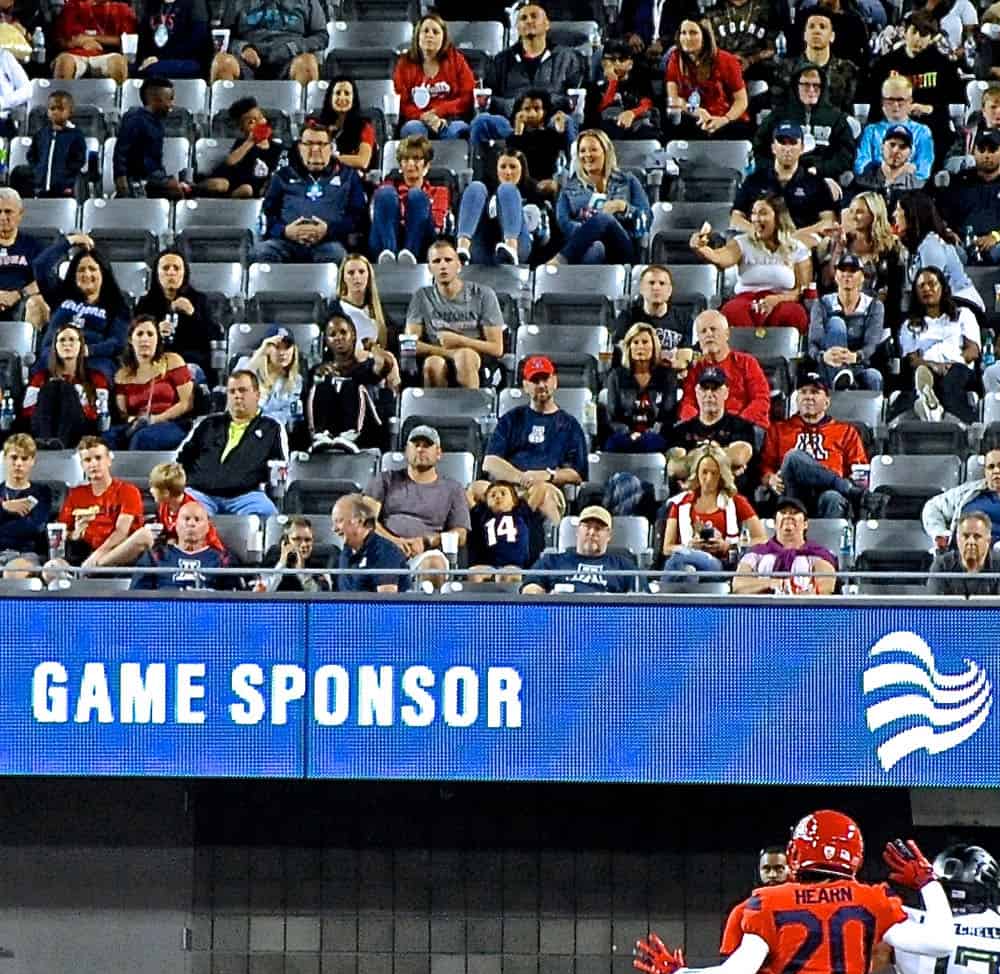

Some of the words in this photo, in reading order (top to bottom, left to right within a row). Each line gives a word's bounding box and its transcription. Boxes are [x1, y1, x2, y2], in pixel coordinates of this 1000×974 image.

[485, 515, 518, 547] 14
[32, 660, 207, 725] GAME
[228, 663, 523, 729] SPONSOR
[795, 886, 852, 905] HEARN
